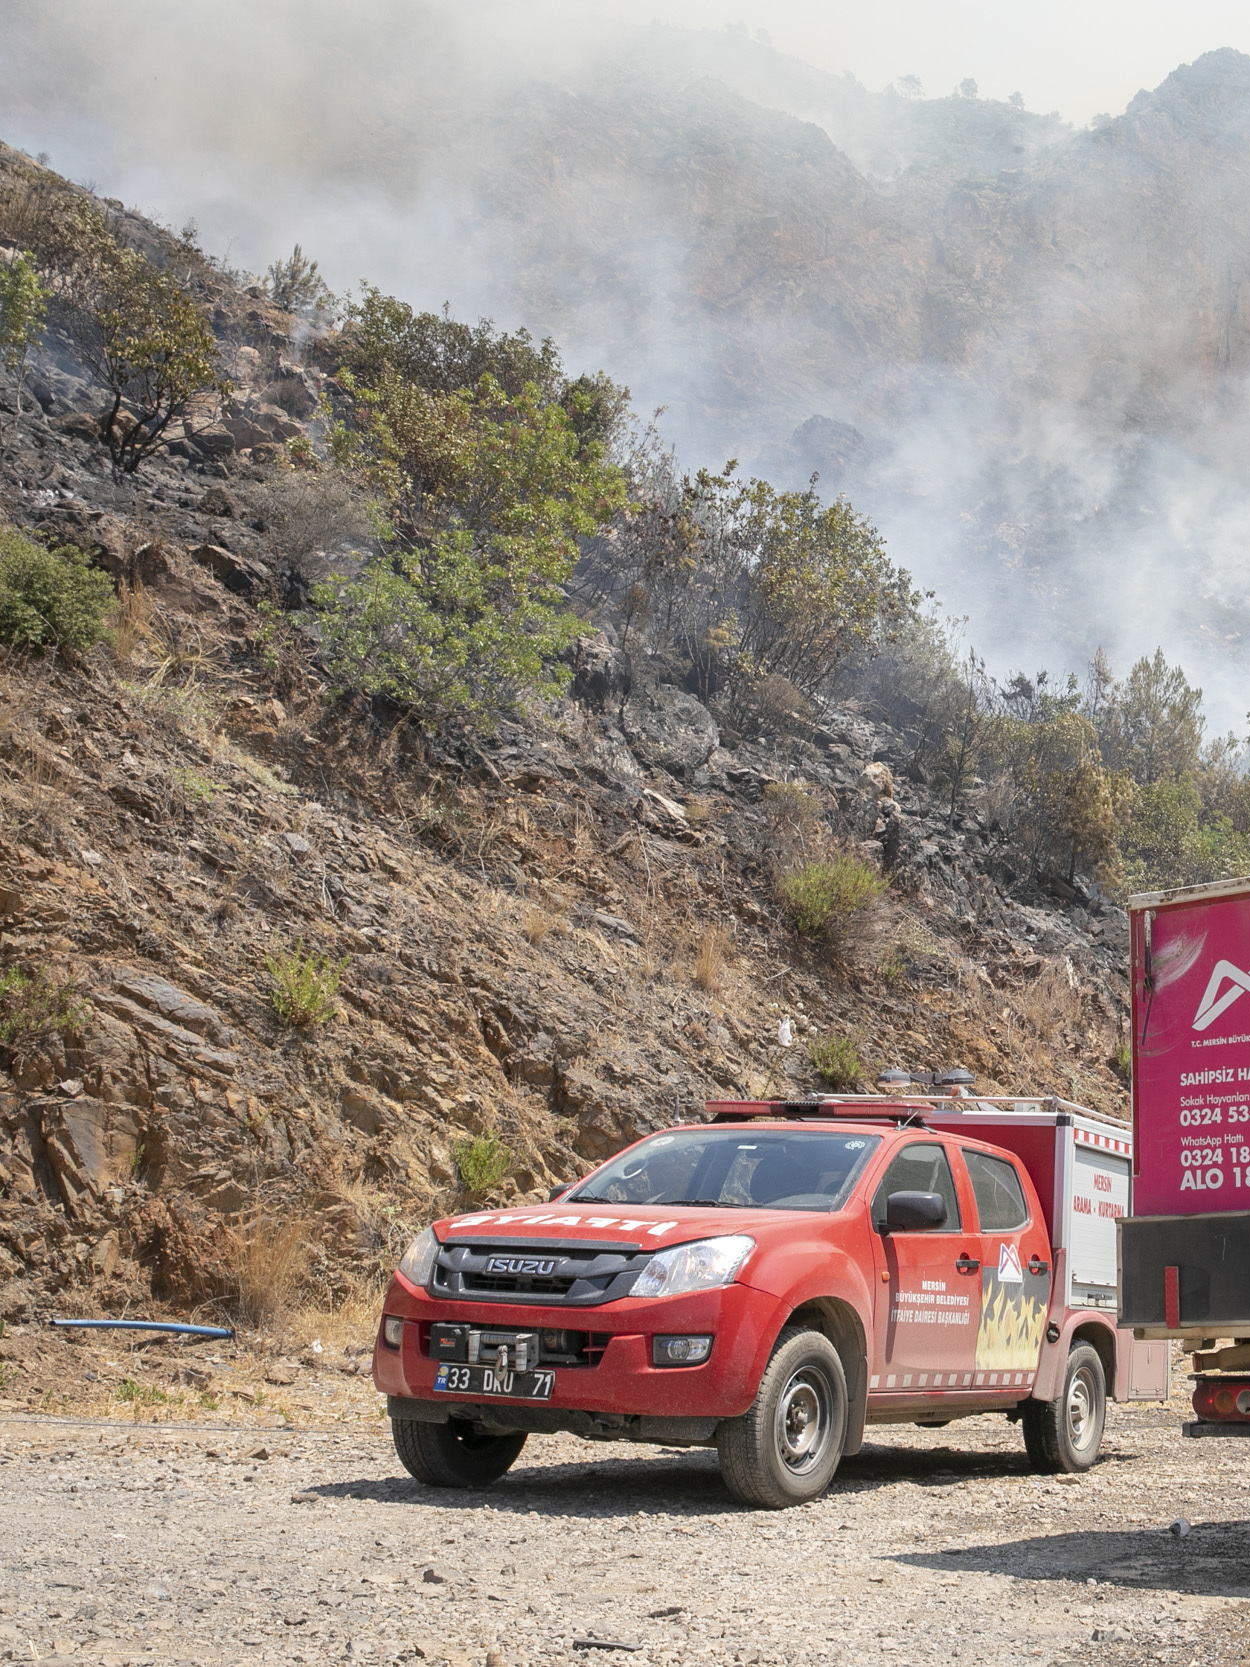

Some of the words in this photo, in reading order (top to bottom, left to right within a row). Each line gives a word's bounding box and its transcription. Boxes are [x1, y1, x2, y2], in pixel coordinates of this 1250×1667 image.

[1191, 1040, 1202, 1048] T.C.
[1203, 1037, 1227, 1047] MERSİN
[1180, 1066, 1234, 1086] SAHİPSİZ
[1180, 1094, 1204, 1107] Sokak
[1206, 1091, 1250, 1106] Hayvanları
[1180, 1107, 1222, 1126] 0324
[1180, 1135, 1222, 1147] WhatsApp
[1224, 1133, 1244, 1144] Hattı
[1181, 1148, 1223, 1167] 0324
[1180, 1167, 1224, 1191] ALO
[1073, 1195, 1091, 1215] ARAMA
[486, 1258, 555, 1275] ISUZU
[922, 1279, 946, 1292] MERSİN
[895, 1290, 935, 1306] BÜYÜKŞEHİR
[936, 1293, 970, 1306] BELEDİYESİ
[437, 1377, 446, 1385] TR
[448, 1368, 470, 1389] 33
[532, 1373, 552, 1396] 71
